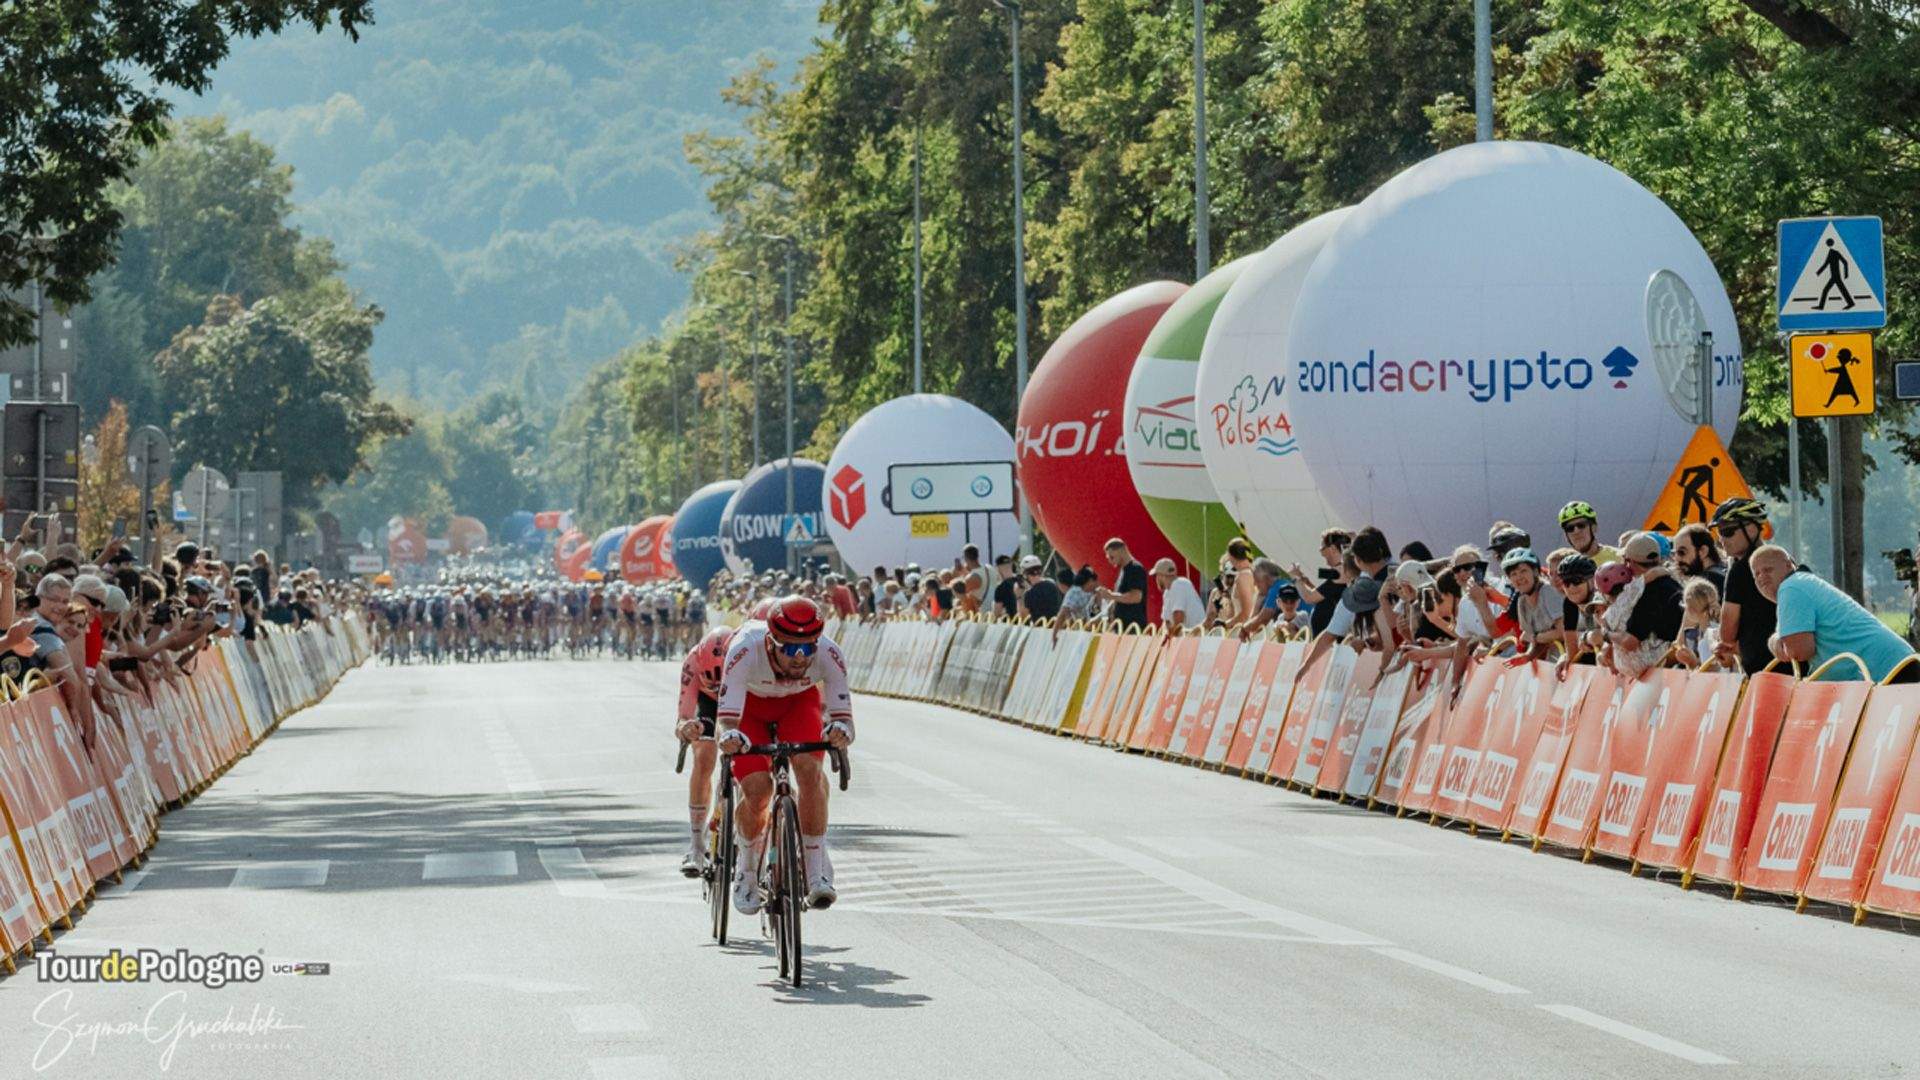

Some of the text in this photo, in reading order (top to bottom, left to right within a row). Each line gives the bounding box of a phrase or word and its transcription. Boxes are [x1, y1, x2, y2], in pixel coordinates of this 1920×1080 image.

[1298, 348, 1593, 402] zondacrypto
[912, 519, 949, 534] 500m
[678, 536, 728, 550] CITYBO
